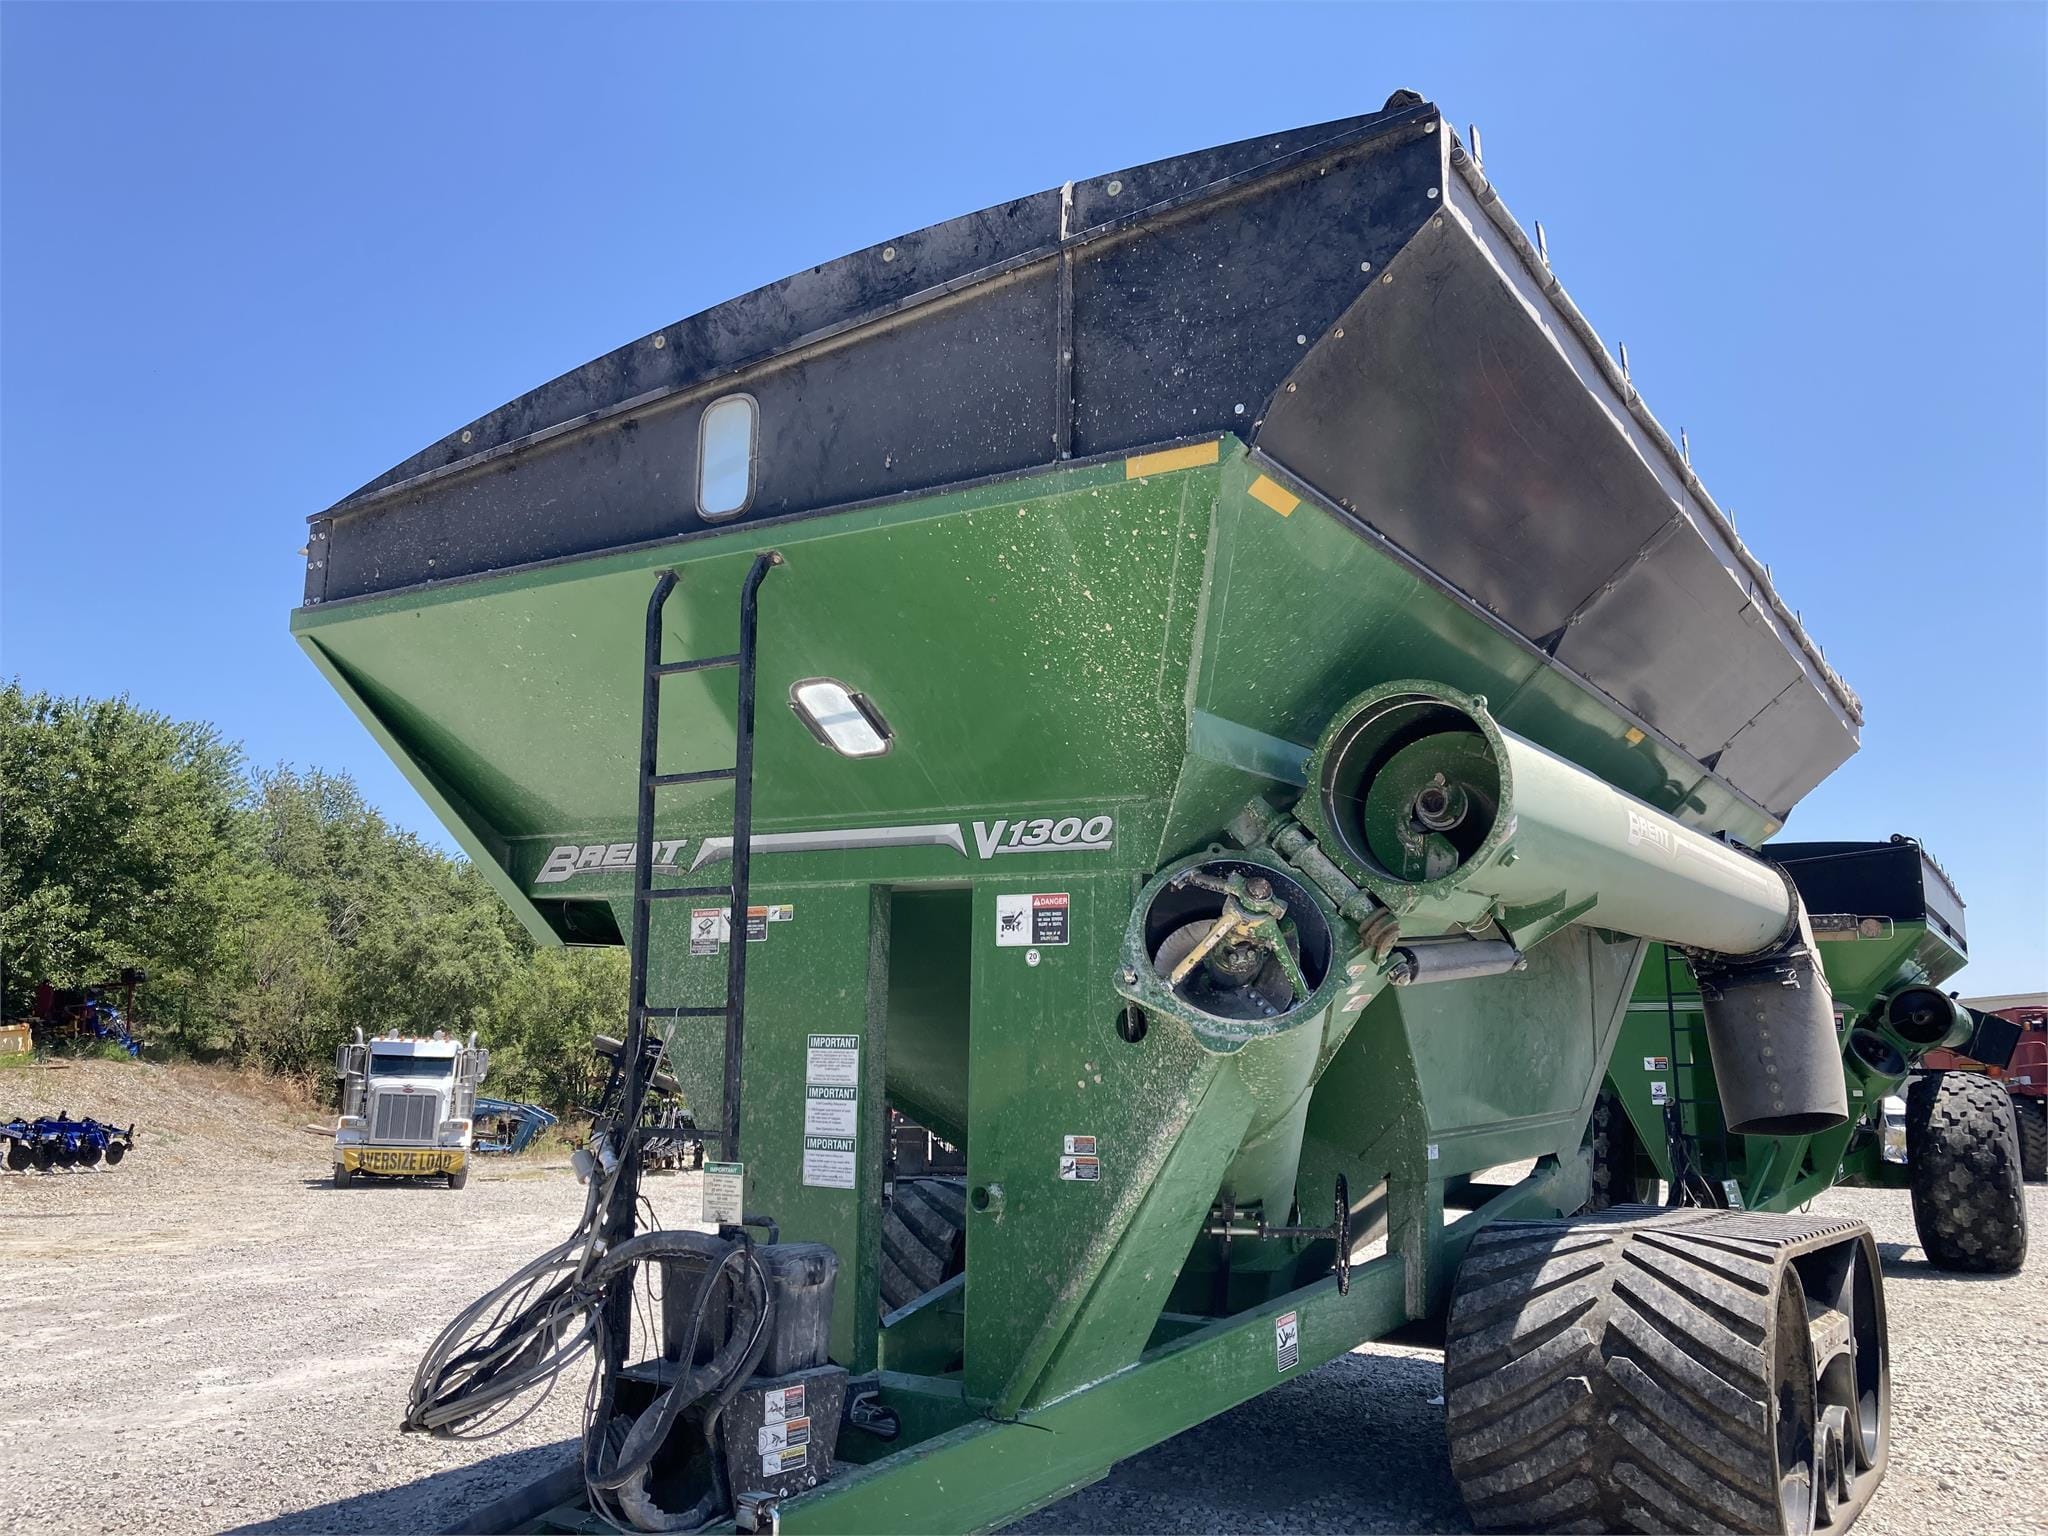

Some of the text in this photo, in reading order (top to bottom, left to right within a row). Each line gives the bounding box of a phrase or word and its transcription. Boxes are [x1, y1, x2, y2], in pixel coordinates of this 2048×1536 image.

[972, 815, 1113, 859] V1300
[1040, 897, 1067, 905] DANGER
[810, 1036, 856, 1049] IMPORTANT
[808, 1087, 855, 1099] IMPORTANT
[806, 1138, 853, 1151] IMPORTANT
[420, 1153, 452, 1171] LOAD
